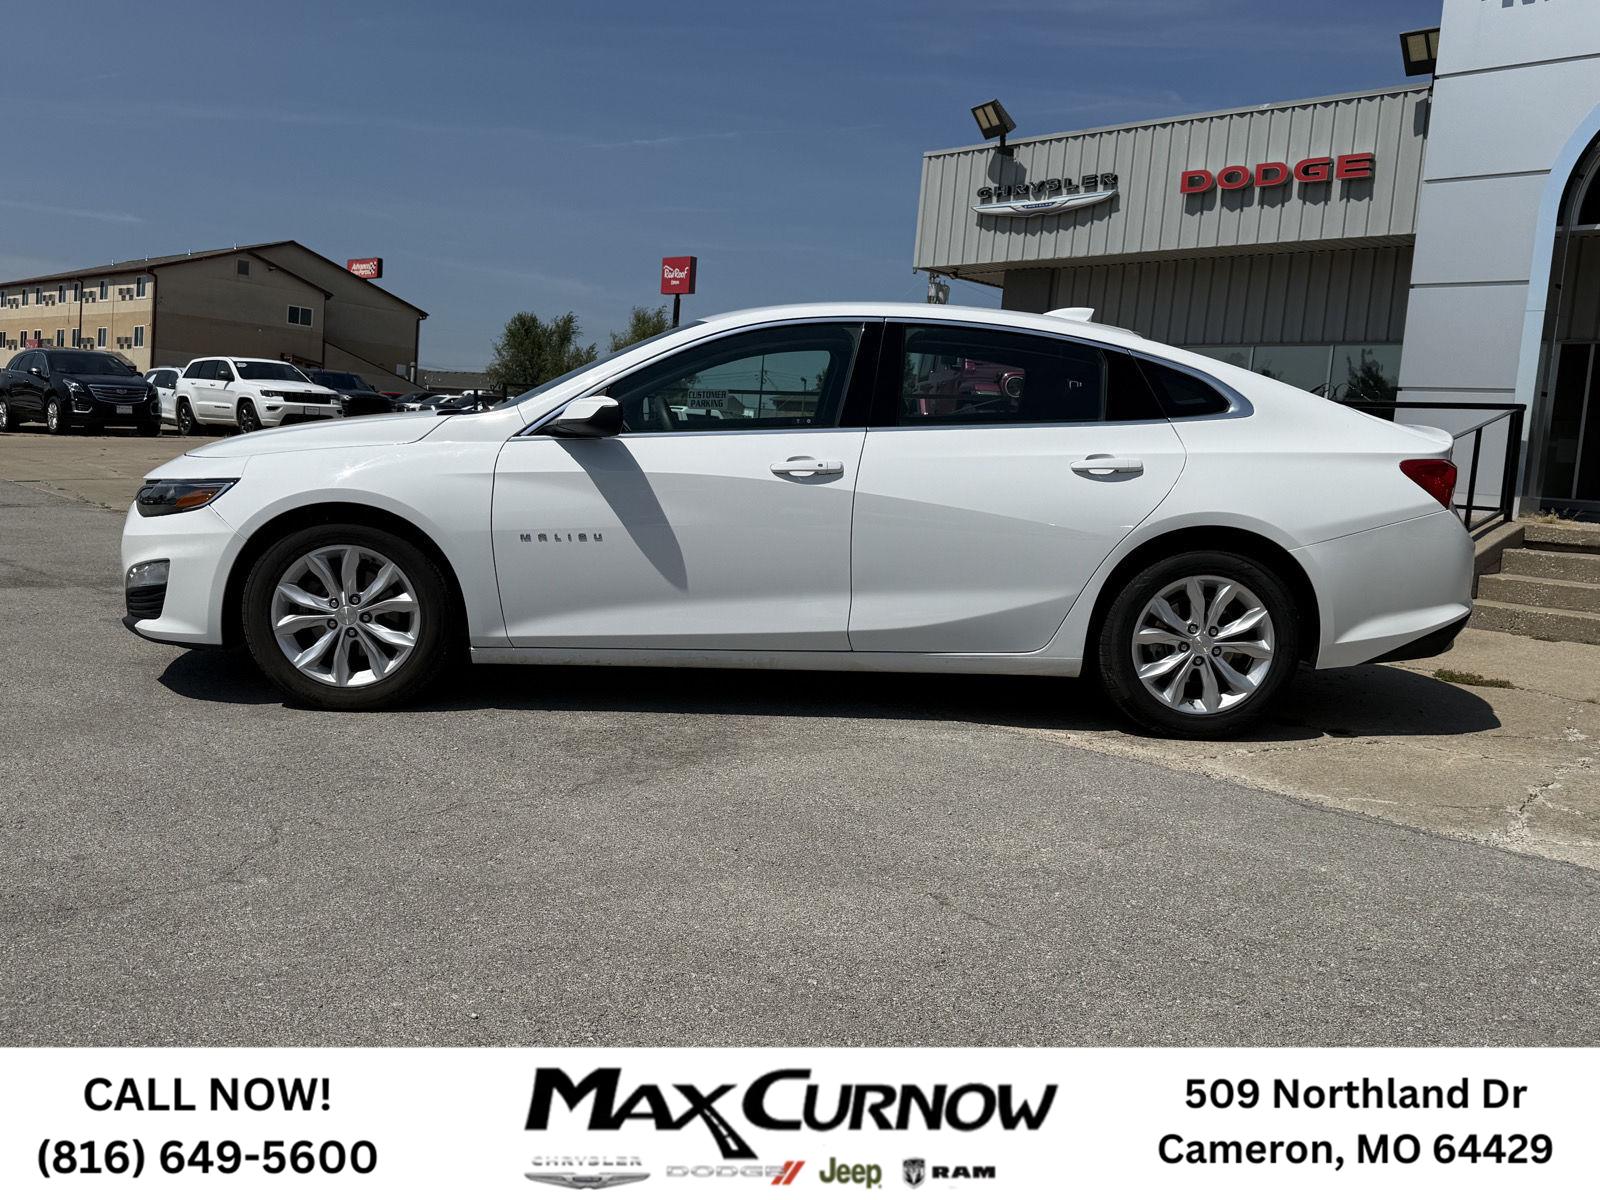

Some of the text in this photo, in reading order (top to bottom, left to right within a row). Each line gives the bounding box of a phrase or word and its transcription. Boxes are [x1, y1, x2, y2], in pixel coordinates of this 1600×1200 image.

[1180, 152, 1375, 194] DODGE
[977, 173, 1119, 199] CHRYSLER
[688, 391, 727, 399] CUSTOMER
[691, 400, 723, 408] PARKING
[519, 533, 603, 542] MALIBU
